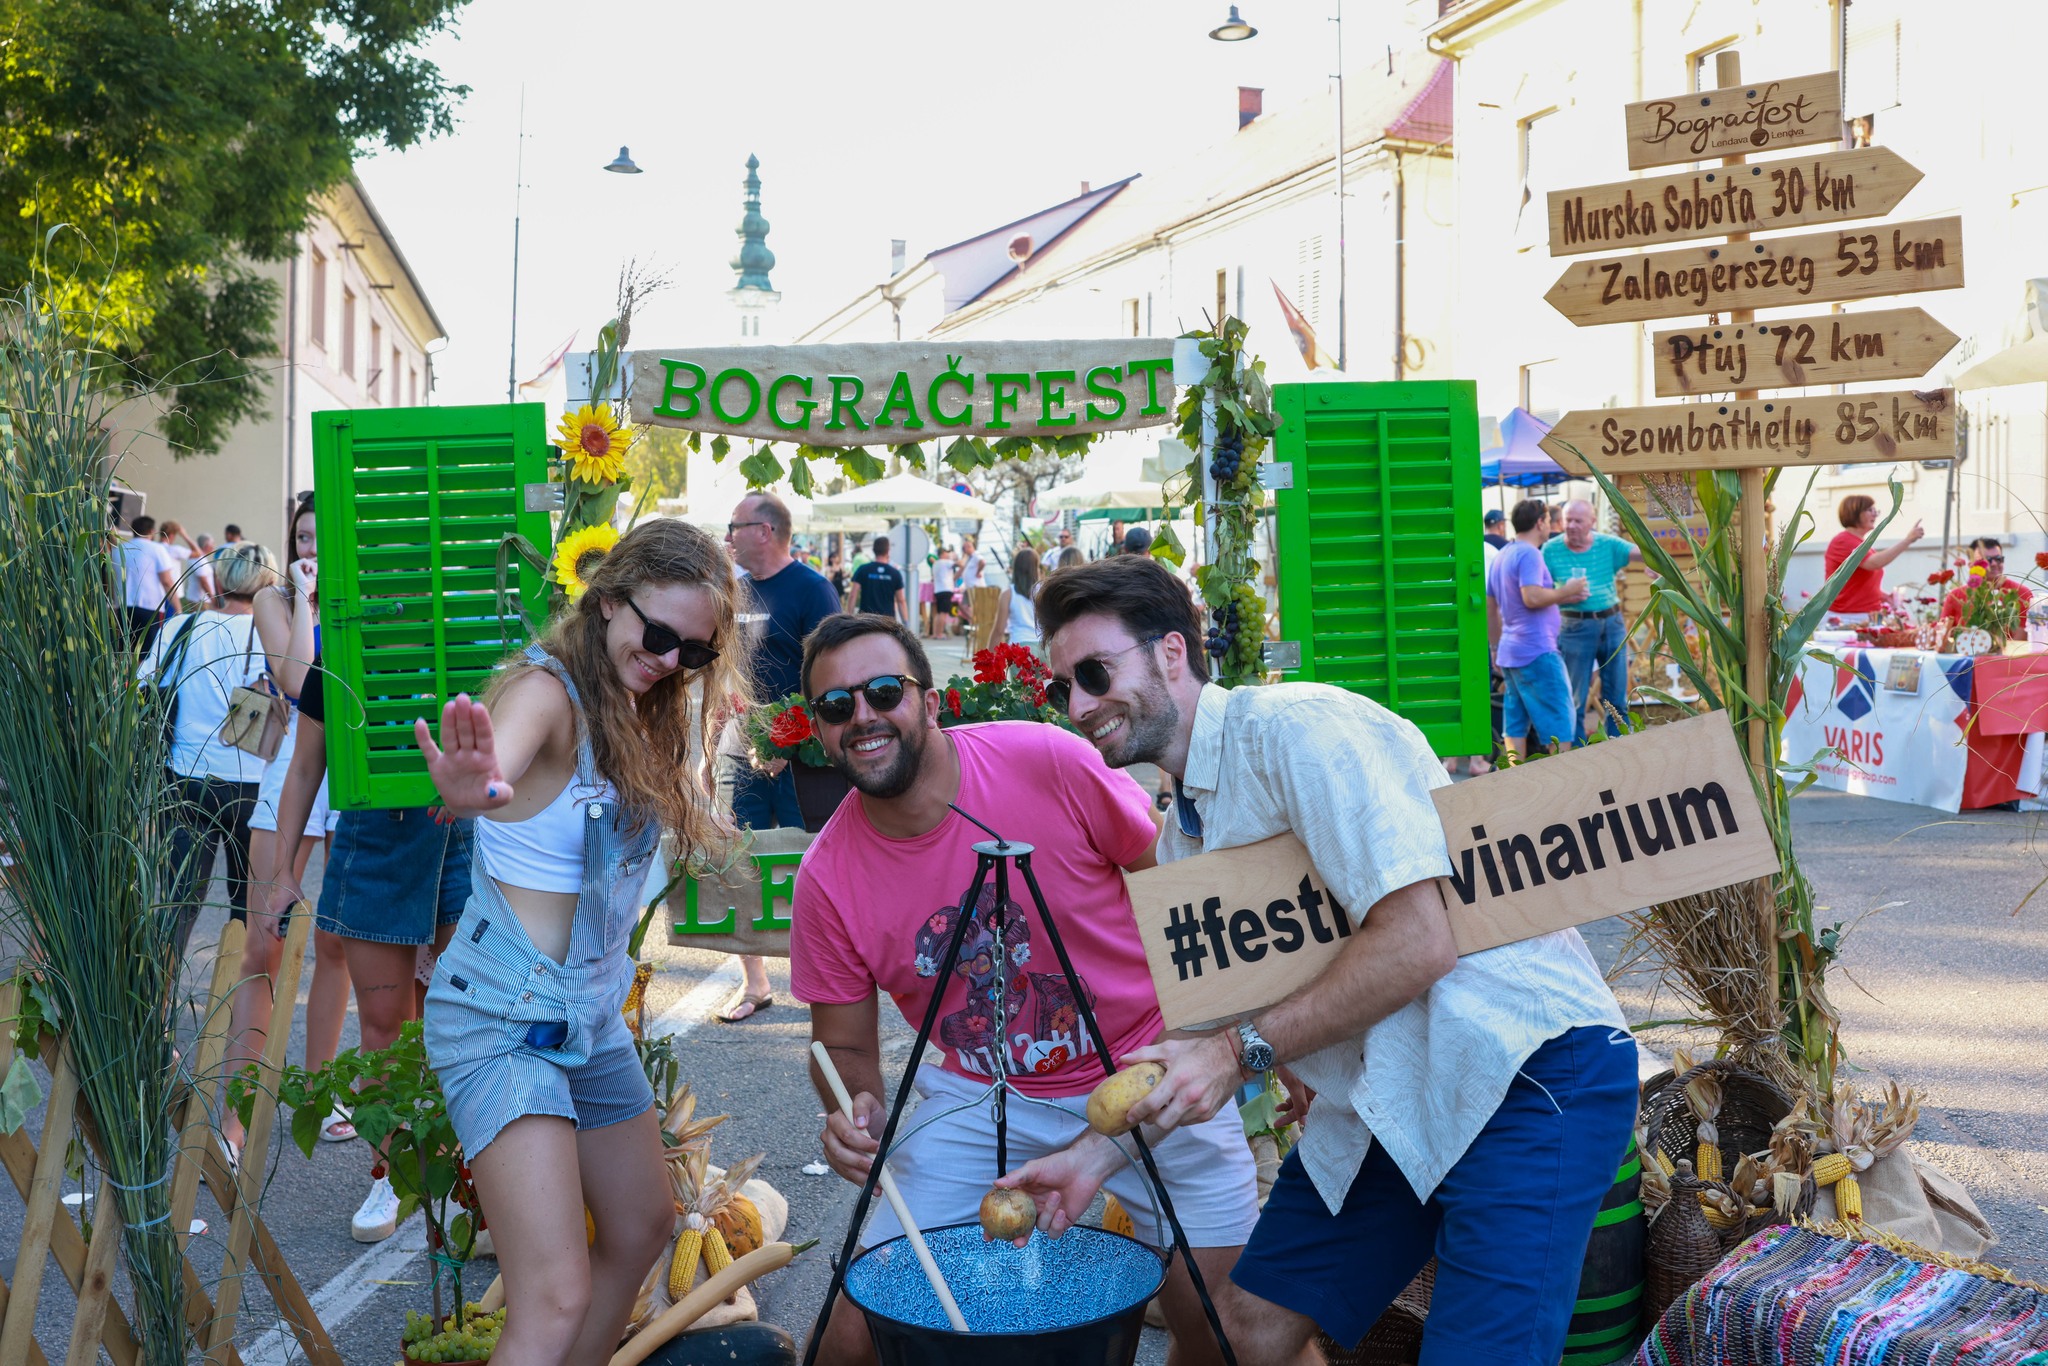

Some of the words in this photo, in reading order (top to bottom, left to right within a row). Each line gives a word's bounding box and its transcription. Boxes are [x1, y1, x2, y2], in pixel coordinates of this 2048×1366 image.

[1711, 136, 1749, 148] Lendava
[1771, 128, 1805, 139] Lendva
[1564, 189, 1657, 246] Murska
[1664, 176, 1756, 233] Sobota
[1771, 166, 1804, 217] 30
[1814, 162, 1856, 211] km
[1601, 256, 1814, 307] Zalaegerszeg
[1837, 233, 1880, 277] 53
[1893, 229, 1945, 271] km
[1668, 329, 1748, 384] Ptuj
[1771, 323, 1817, 366] 72
[1830, 322, 1884, 362] km
[653, 354, 1174, 431] BOGRAČFEST
[1601, 405, 1811, 459] Szombathely
[1836, 401, 1880, 444] 85
[1893, 397, 1938, 443] km
[854, 503, 896, 514] Lendava
[1823, 725, 1884, 767] VARIS
